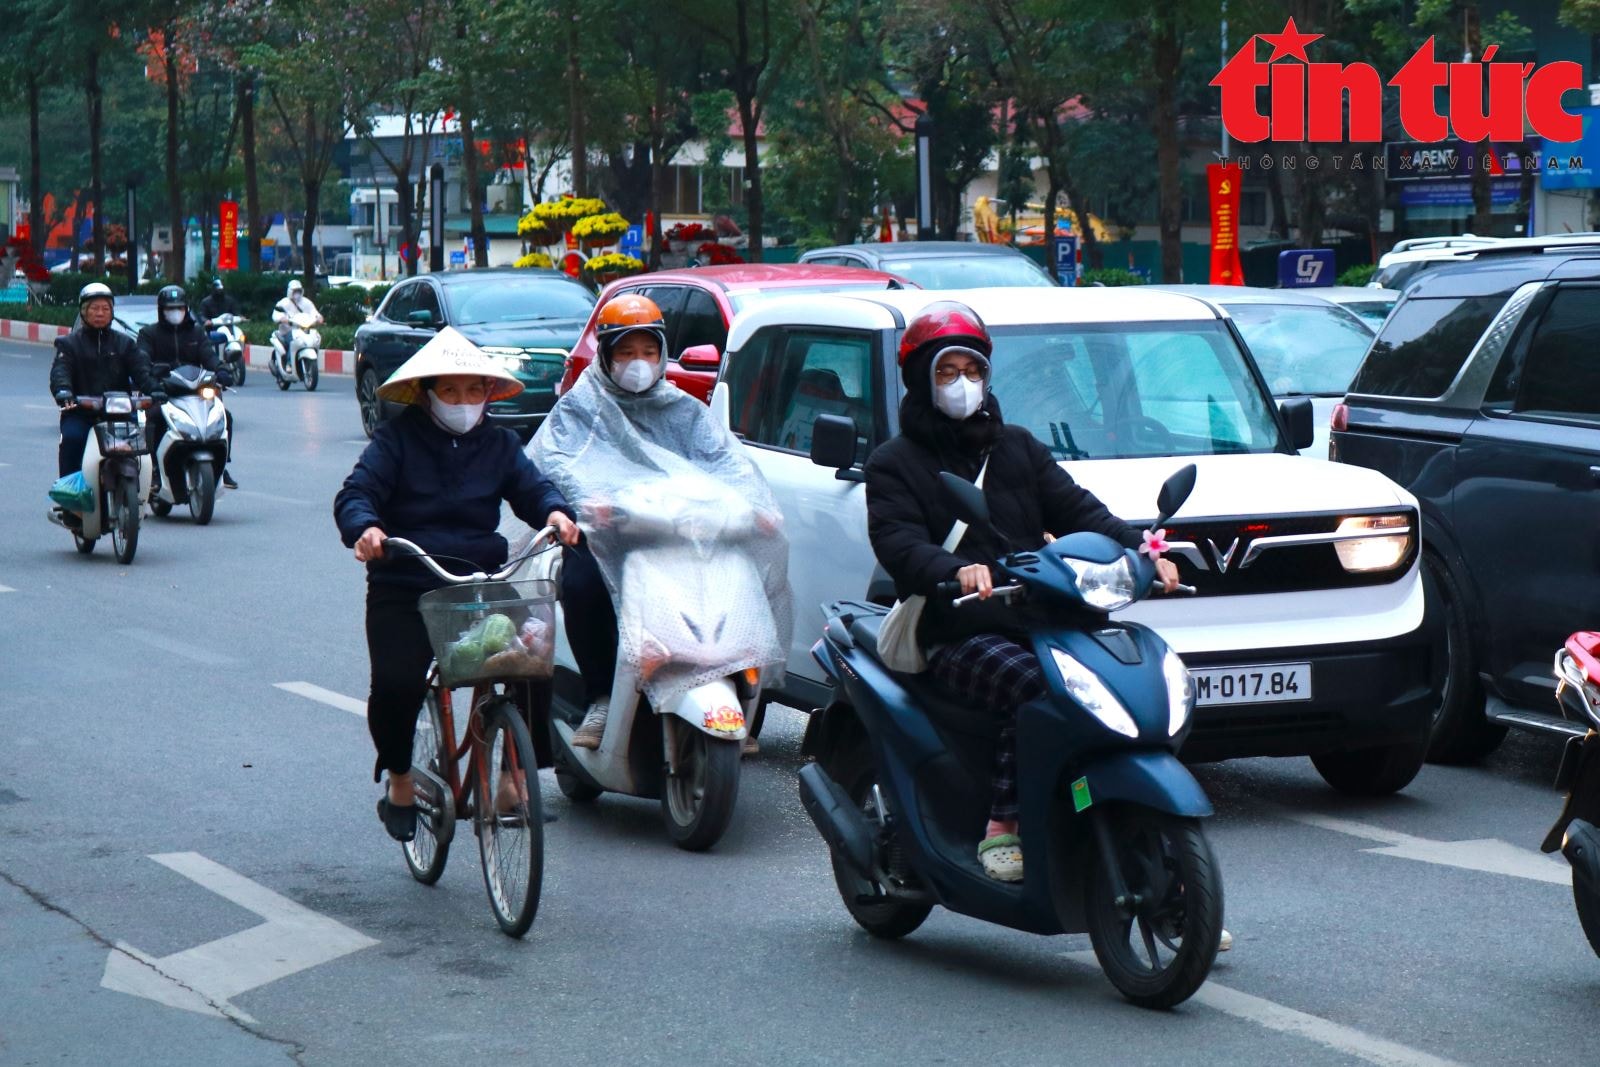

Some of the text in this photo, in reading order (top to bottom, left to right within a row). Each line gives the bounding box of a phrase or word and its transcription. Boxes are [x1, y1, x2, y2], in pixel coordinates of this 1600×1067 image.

[1058, 242, 1071, 262] P
[1296, 254, 1324, 283] G7
[1191, 671, 1299, 699] M-017.84
